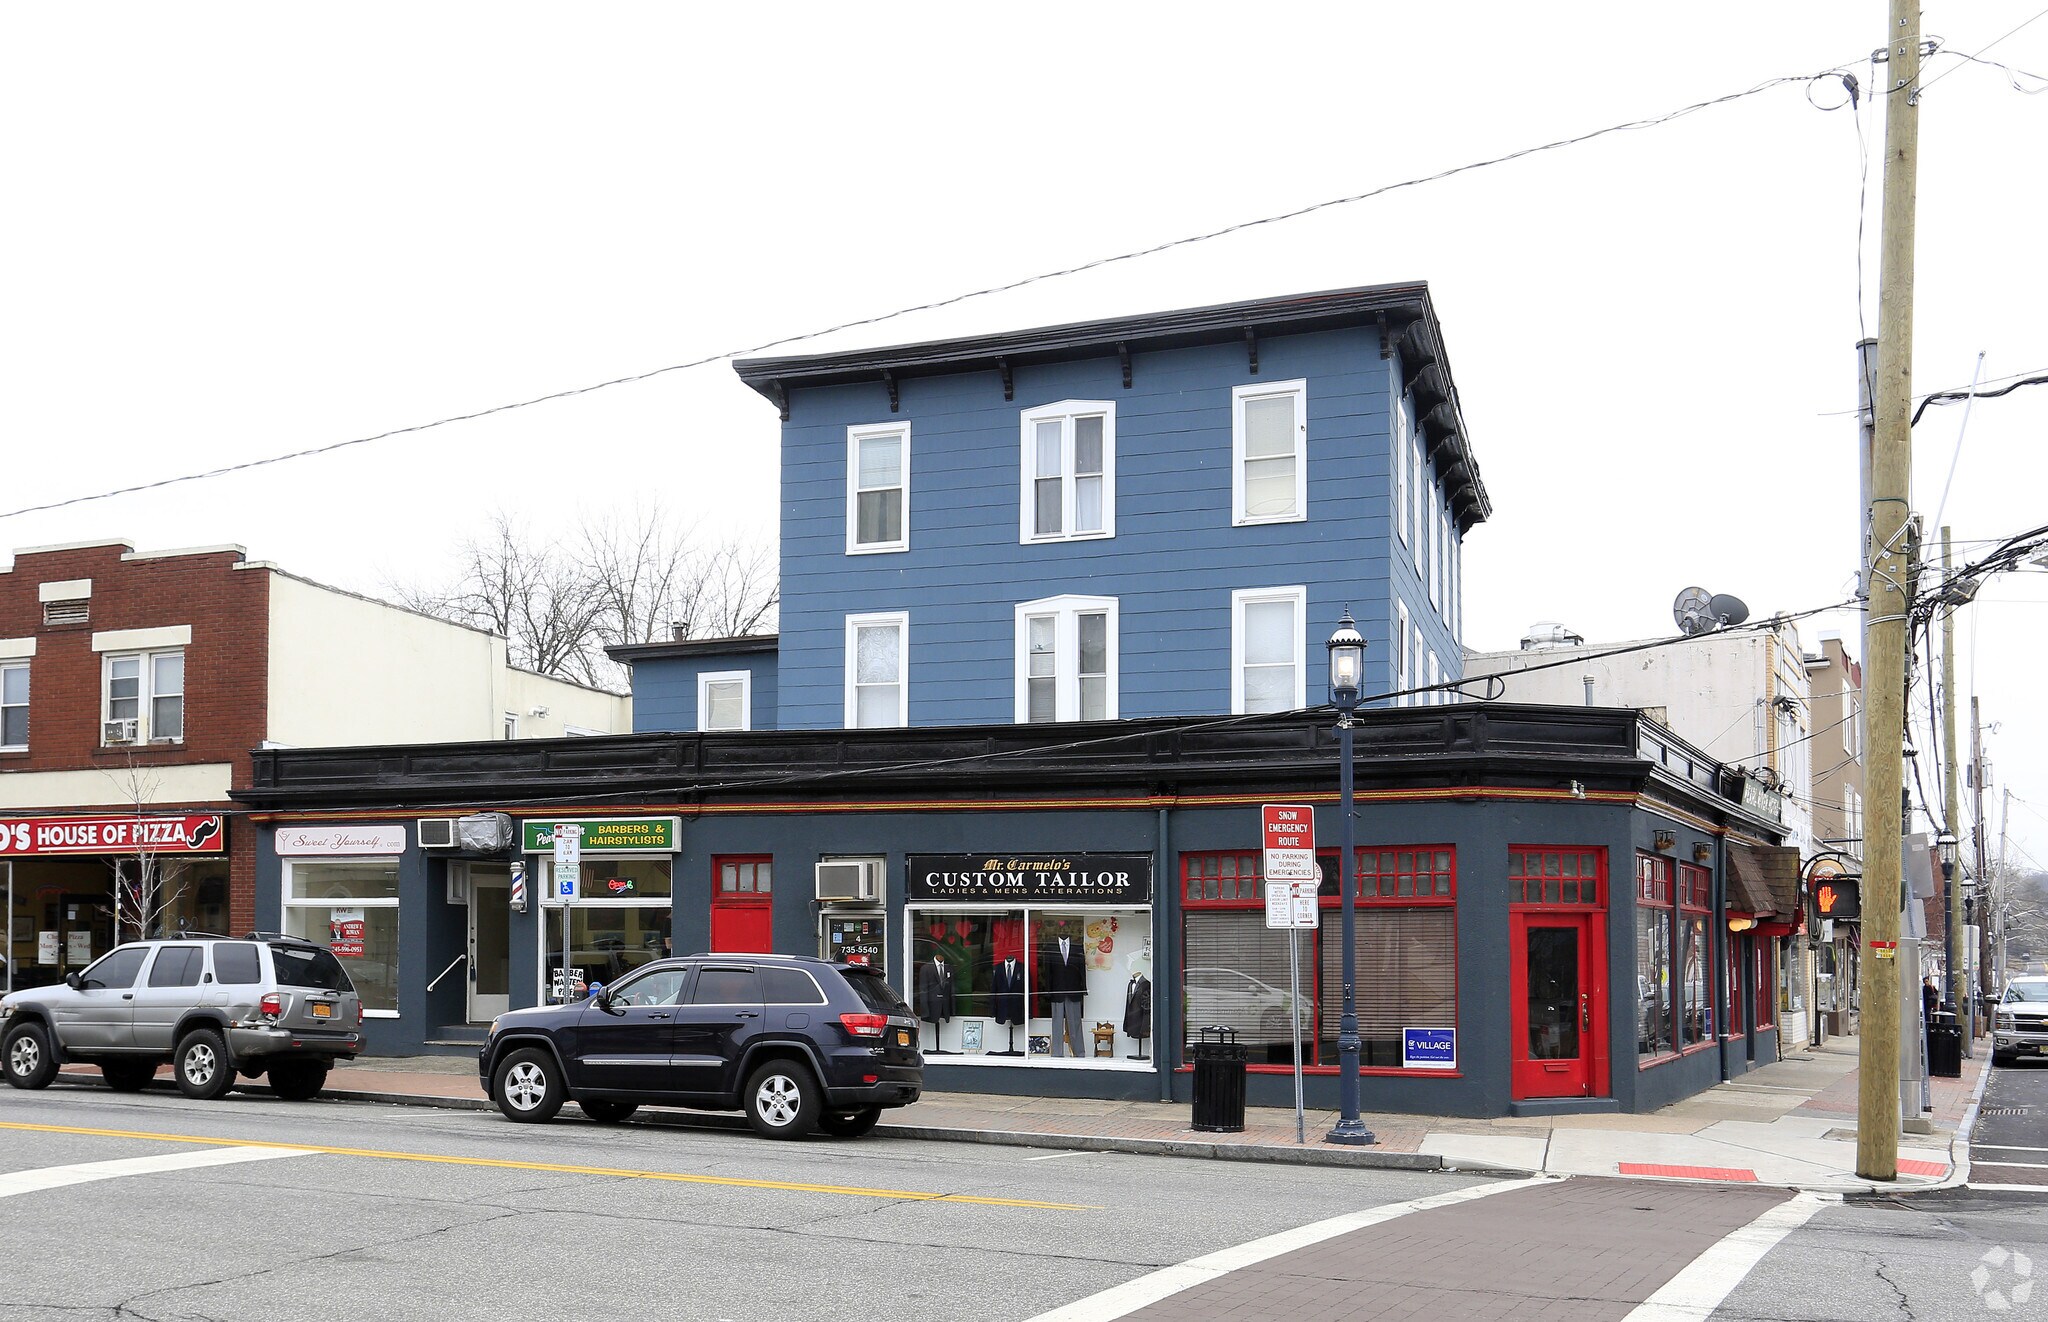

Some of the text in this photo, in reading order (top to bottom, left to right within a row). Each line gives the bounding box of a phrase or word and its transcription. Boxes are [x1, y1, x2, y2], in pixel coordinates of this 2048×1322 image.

[1278, 811, 1298, 820] SNOW
[598, 825, 665, 834] BARBERS &
[1268, 823, 1308, 833] EMERGENCY
[37, 825, 98, 845] HOUSE
[102, 825, 127, 844] OF
[132, 823, 186, 842] PIZZA
[292, 834, 329, 847] Sweet
[589, 836, 665, 845] HAIRSTYLISTS
[1278, 837, 1299, 846] ROUTE
[982, 859, 1071, 871] Mr. Carmelo's
[925, 872, 1131, 887] CUSTOM TAILOR
[841, 946, 878, 954] 735-5540
[553, 969, 583, 979] BABER
[1416, 1041, 1451, 1050] VILLAGE
